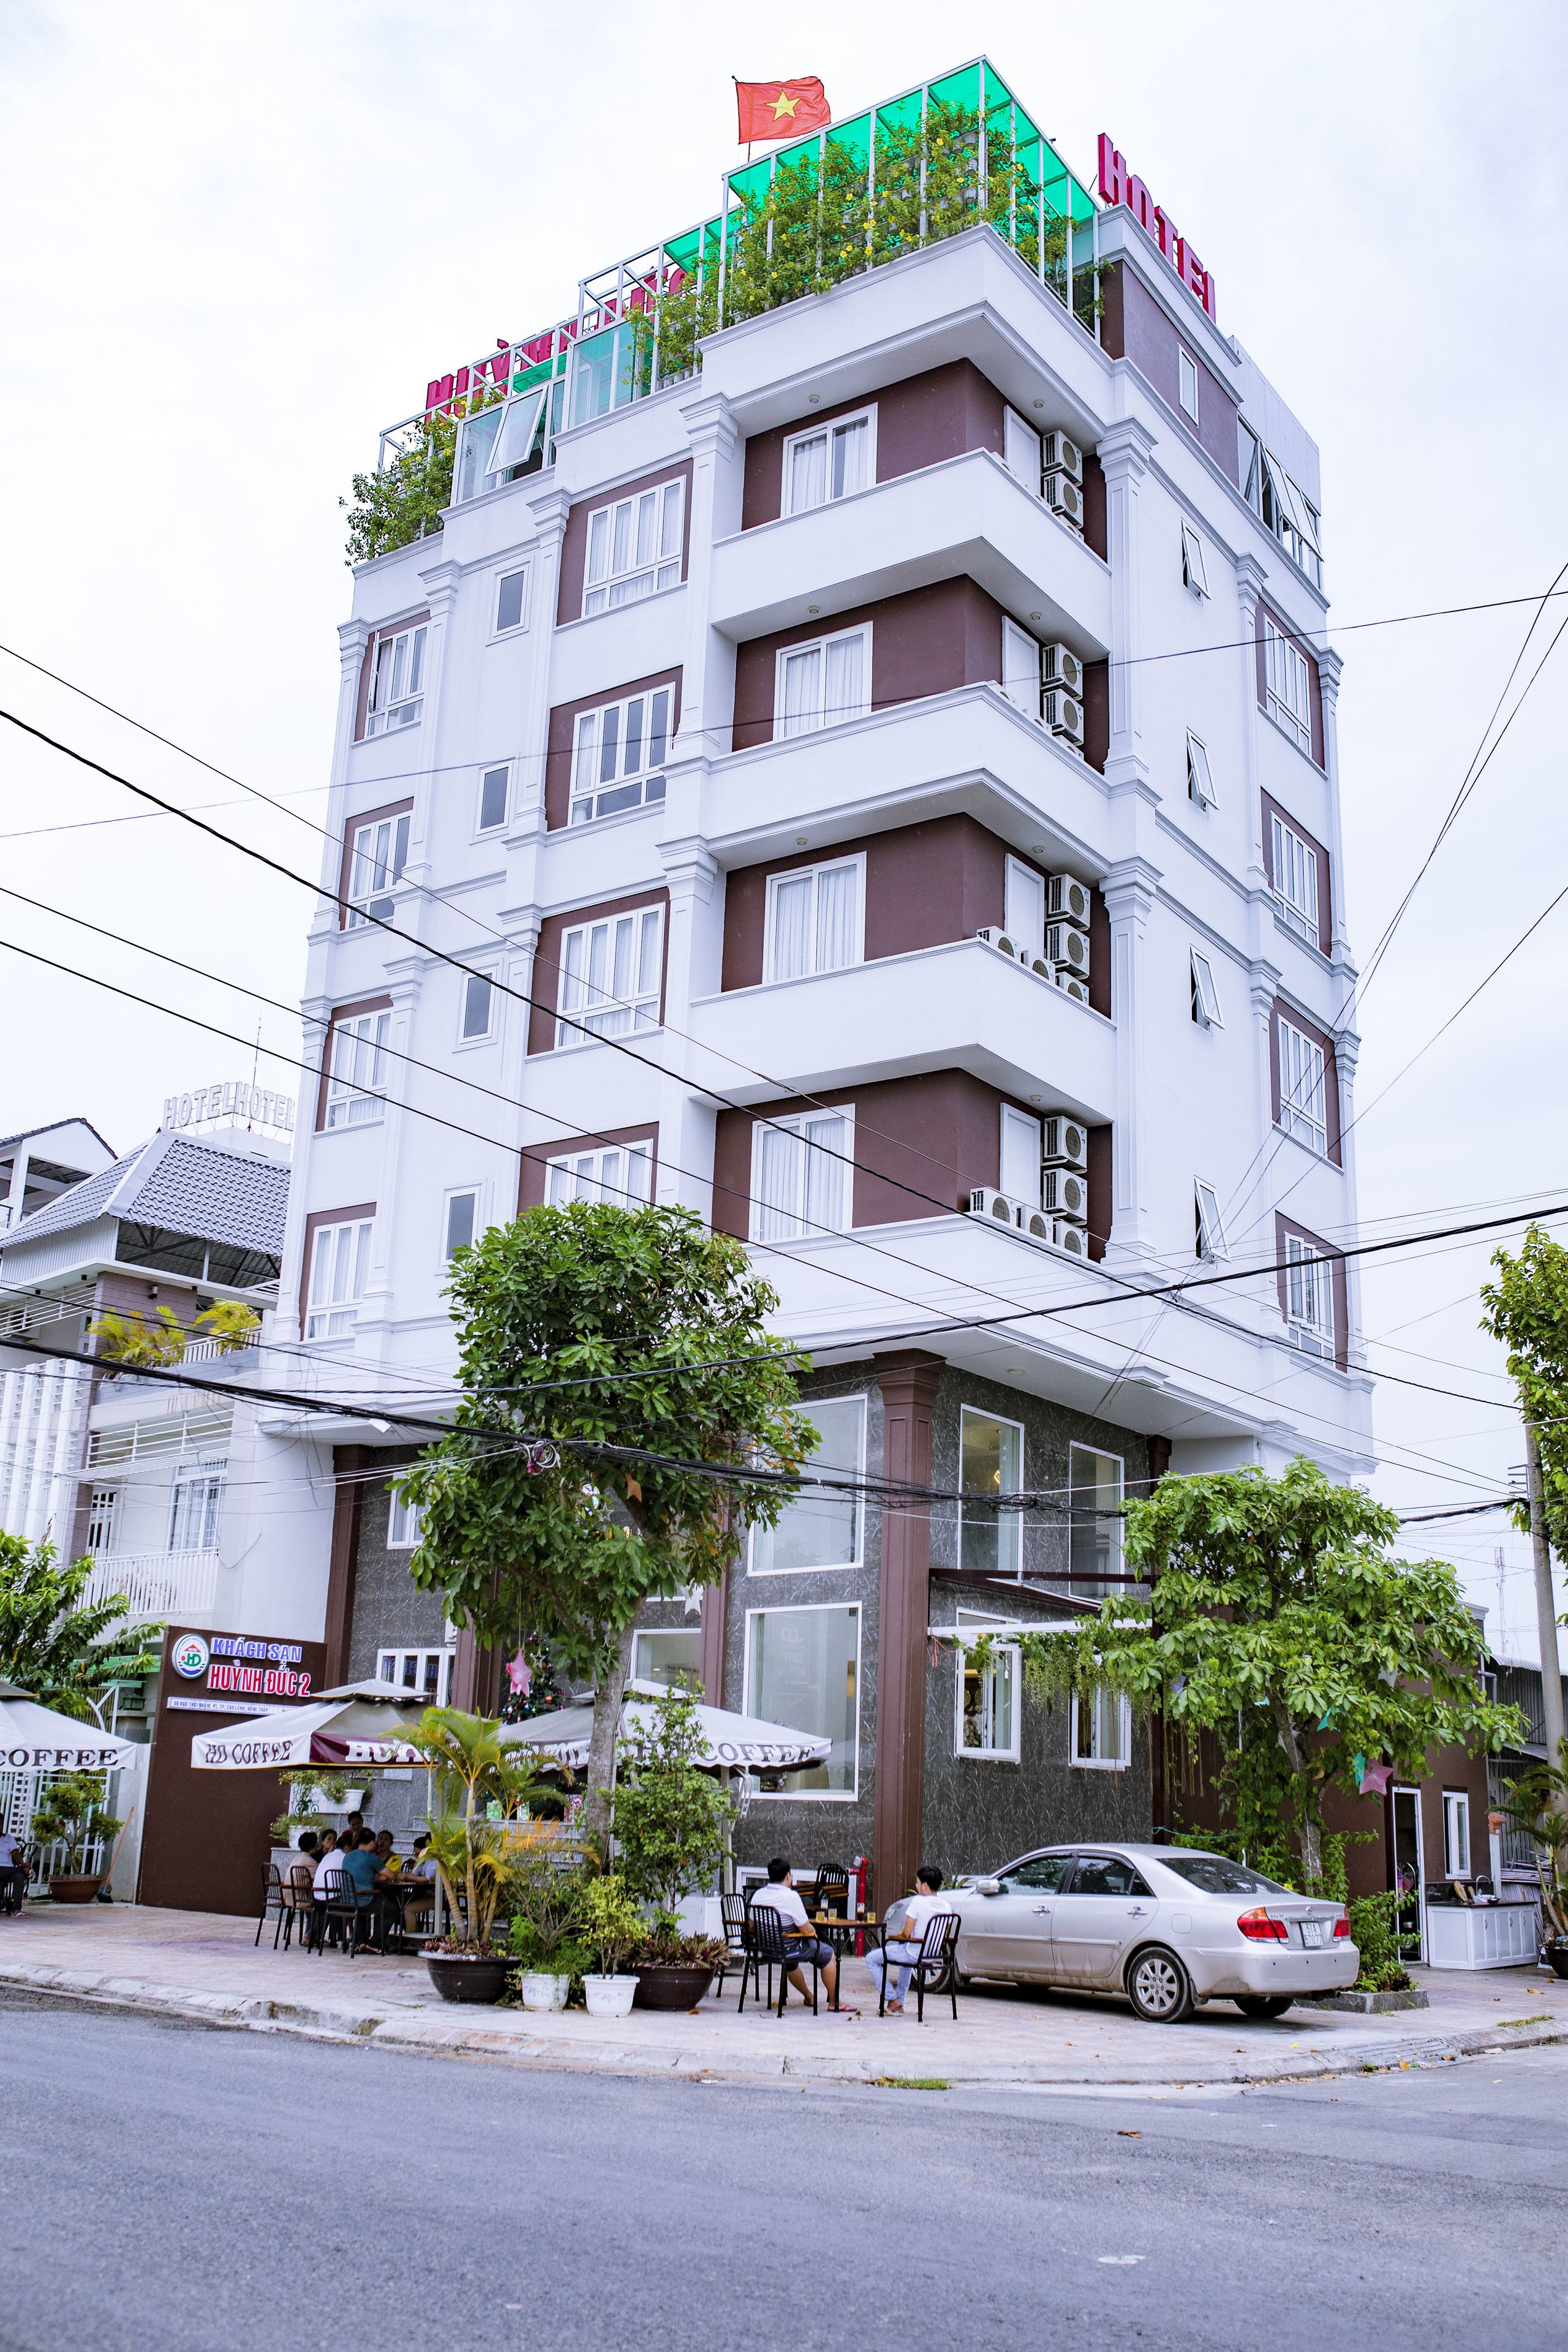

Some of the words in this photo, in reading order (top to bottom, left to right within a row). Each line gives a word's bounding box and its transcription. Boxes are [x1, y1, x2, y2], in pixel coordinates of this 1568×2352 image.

[163, 1082, 234, 1129] HOTEL
[234, 1081, 295, 1131] HOTEL
[211, 1637, 266, 1659] KHÁCH
[267, 1643, 303, 1665] SẠN
[207, 1659, 263, 1693] HUỲNH
[263, 1664, 297, 1697] ĐỨC
[298, 1672, 311, 1697] 2
[205, 1744, 227, 1764] HD
[232, 1740, 293, 1765] COFFEE
[1303, 1934, 1322, 1945] 57077
[1305, 1923, 1317, 1934] 51A
